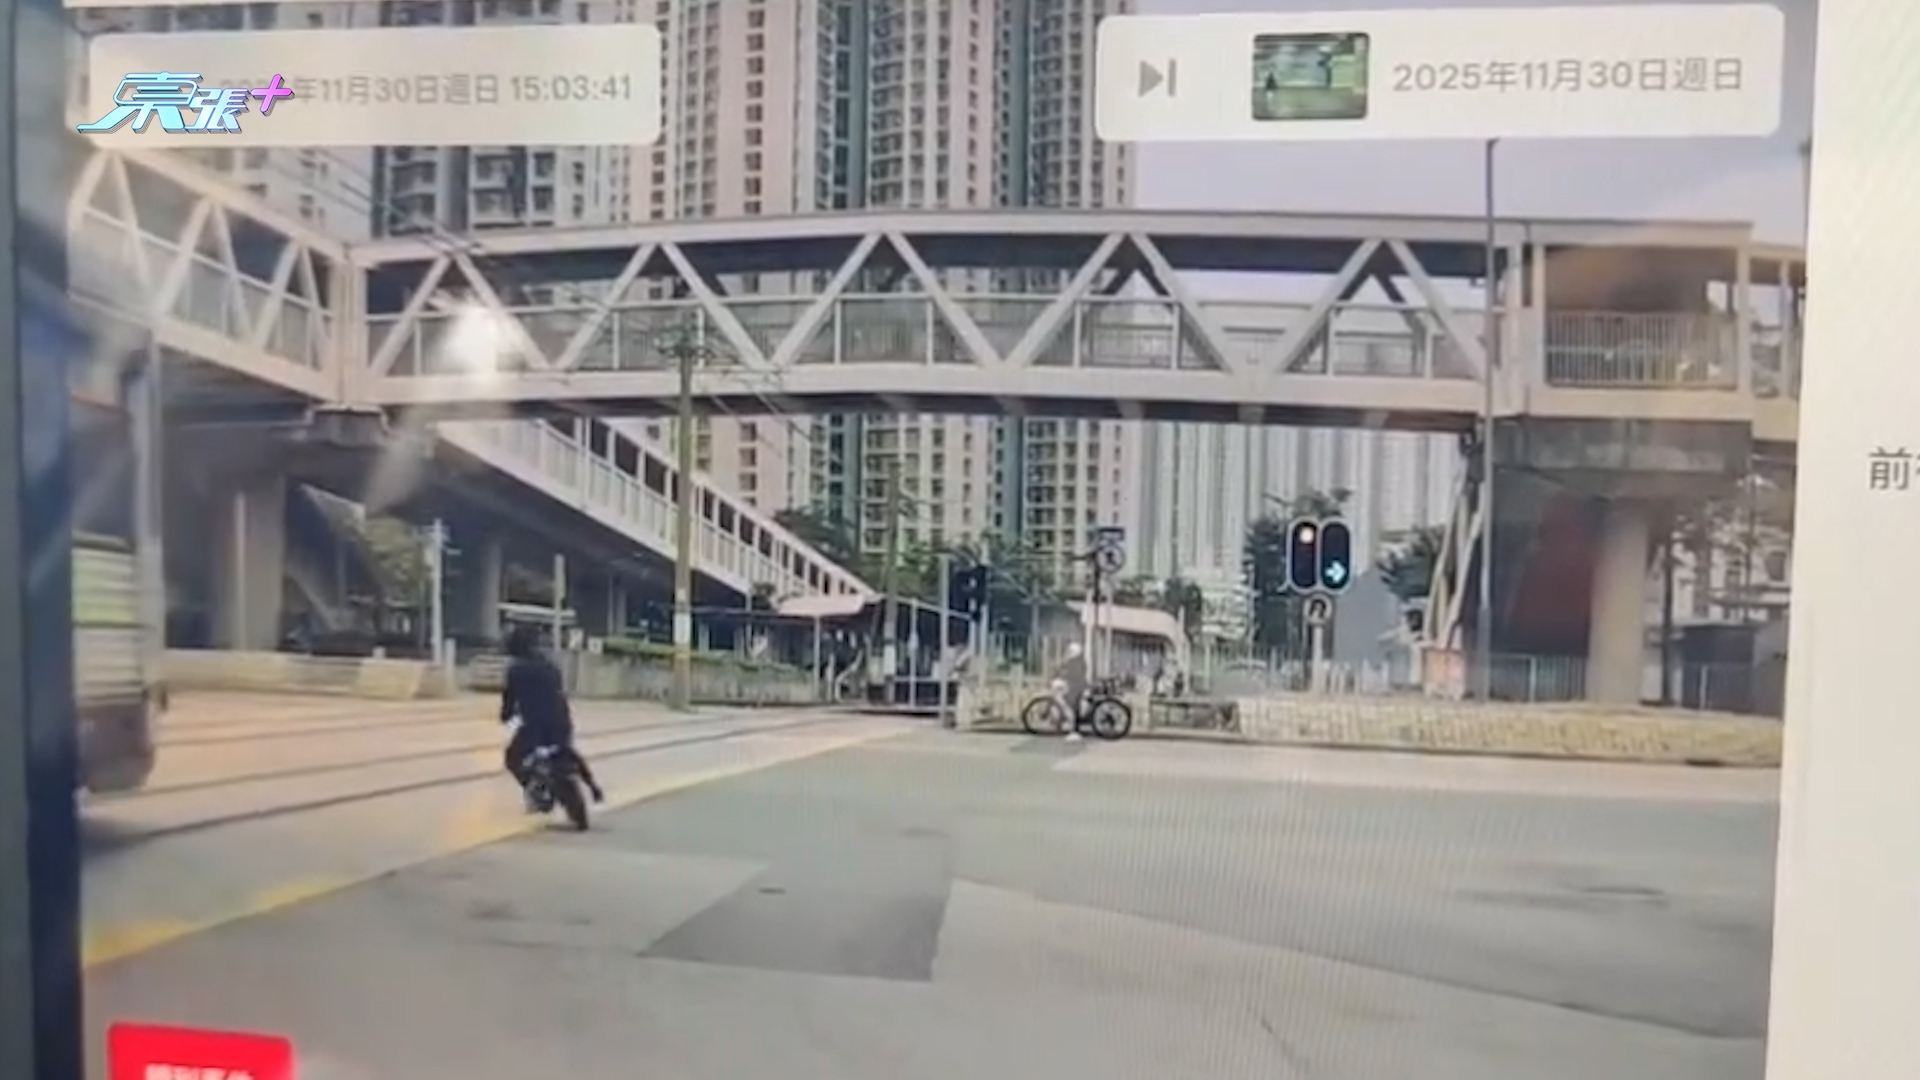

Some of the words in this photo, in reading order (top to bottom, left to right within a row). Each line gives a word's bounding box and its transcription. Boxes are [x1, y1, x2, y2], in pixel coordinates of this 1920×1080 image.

[219, 73, 499, 106] 年11月30日週日
[511, 72, 632, 102] 15:03:41
[1393, 57, 1742, 93] 2025年11月30日週日
[1868, 446, 1920, 490] 前
